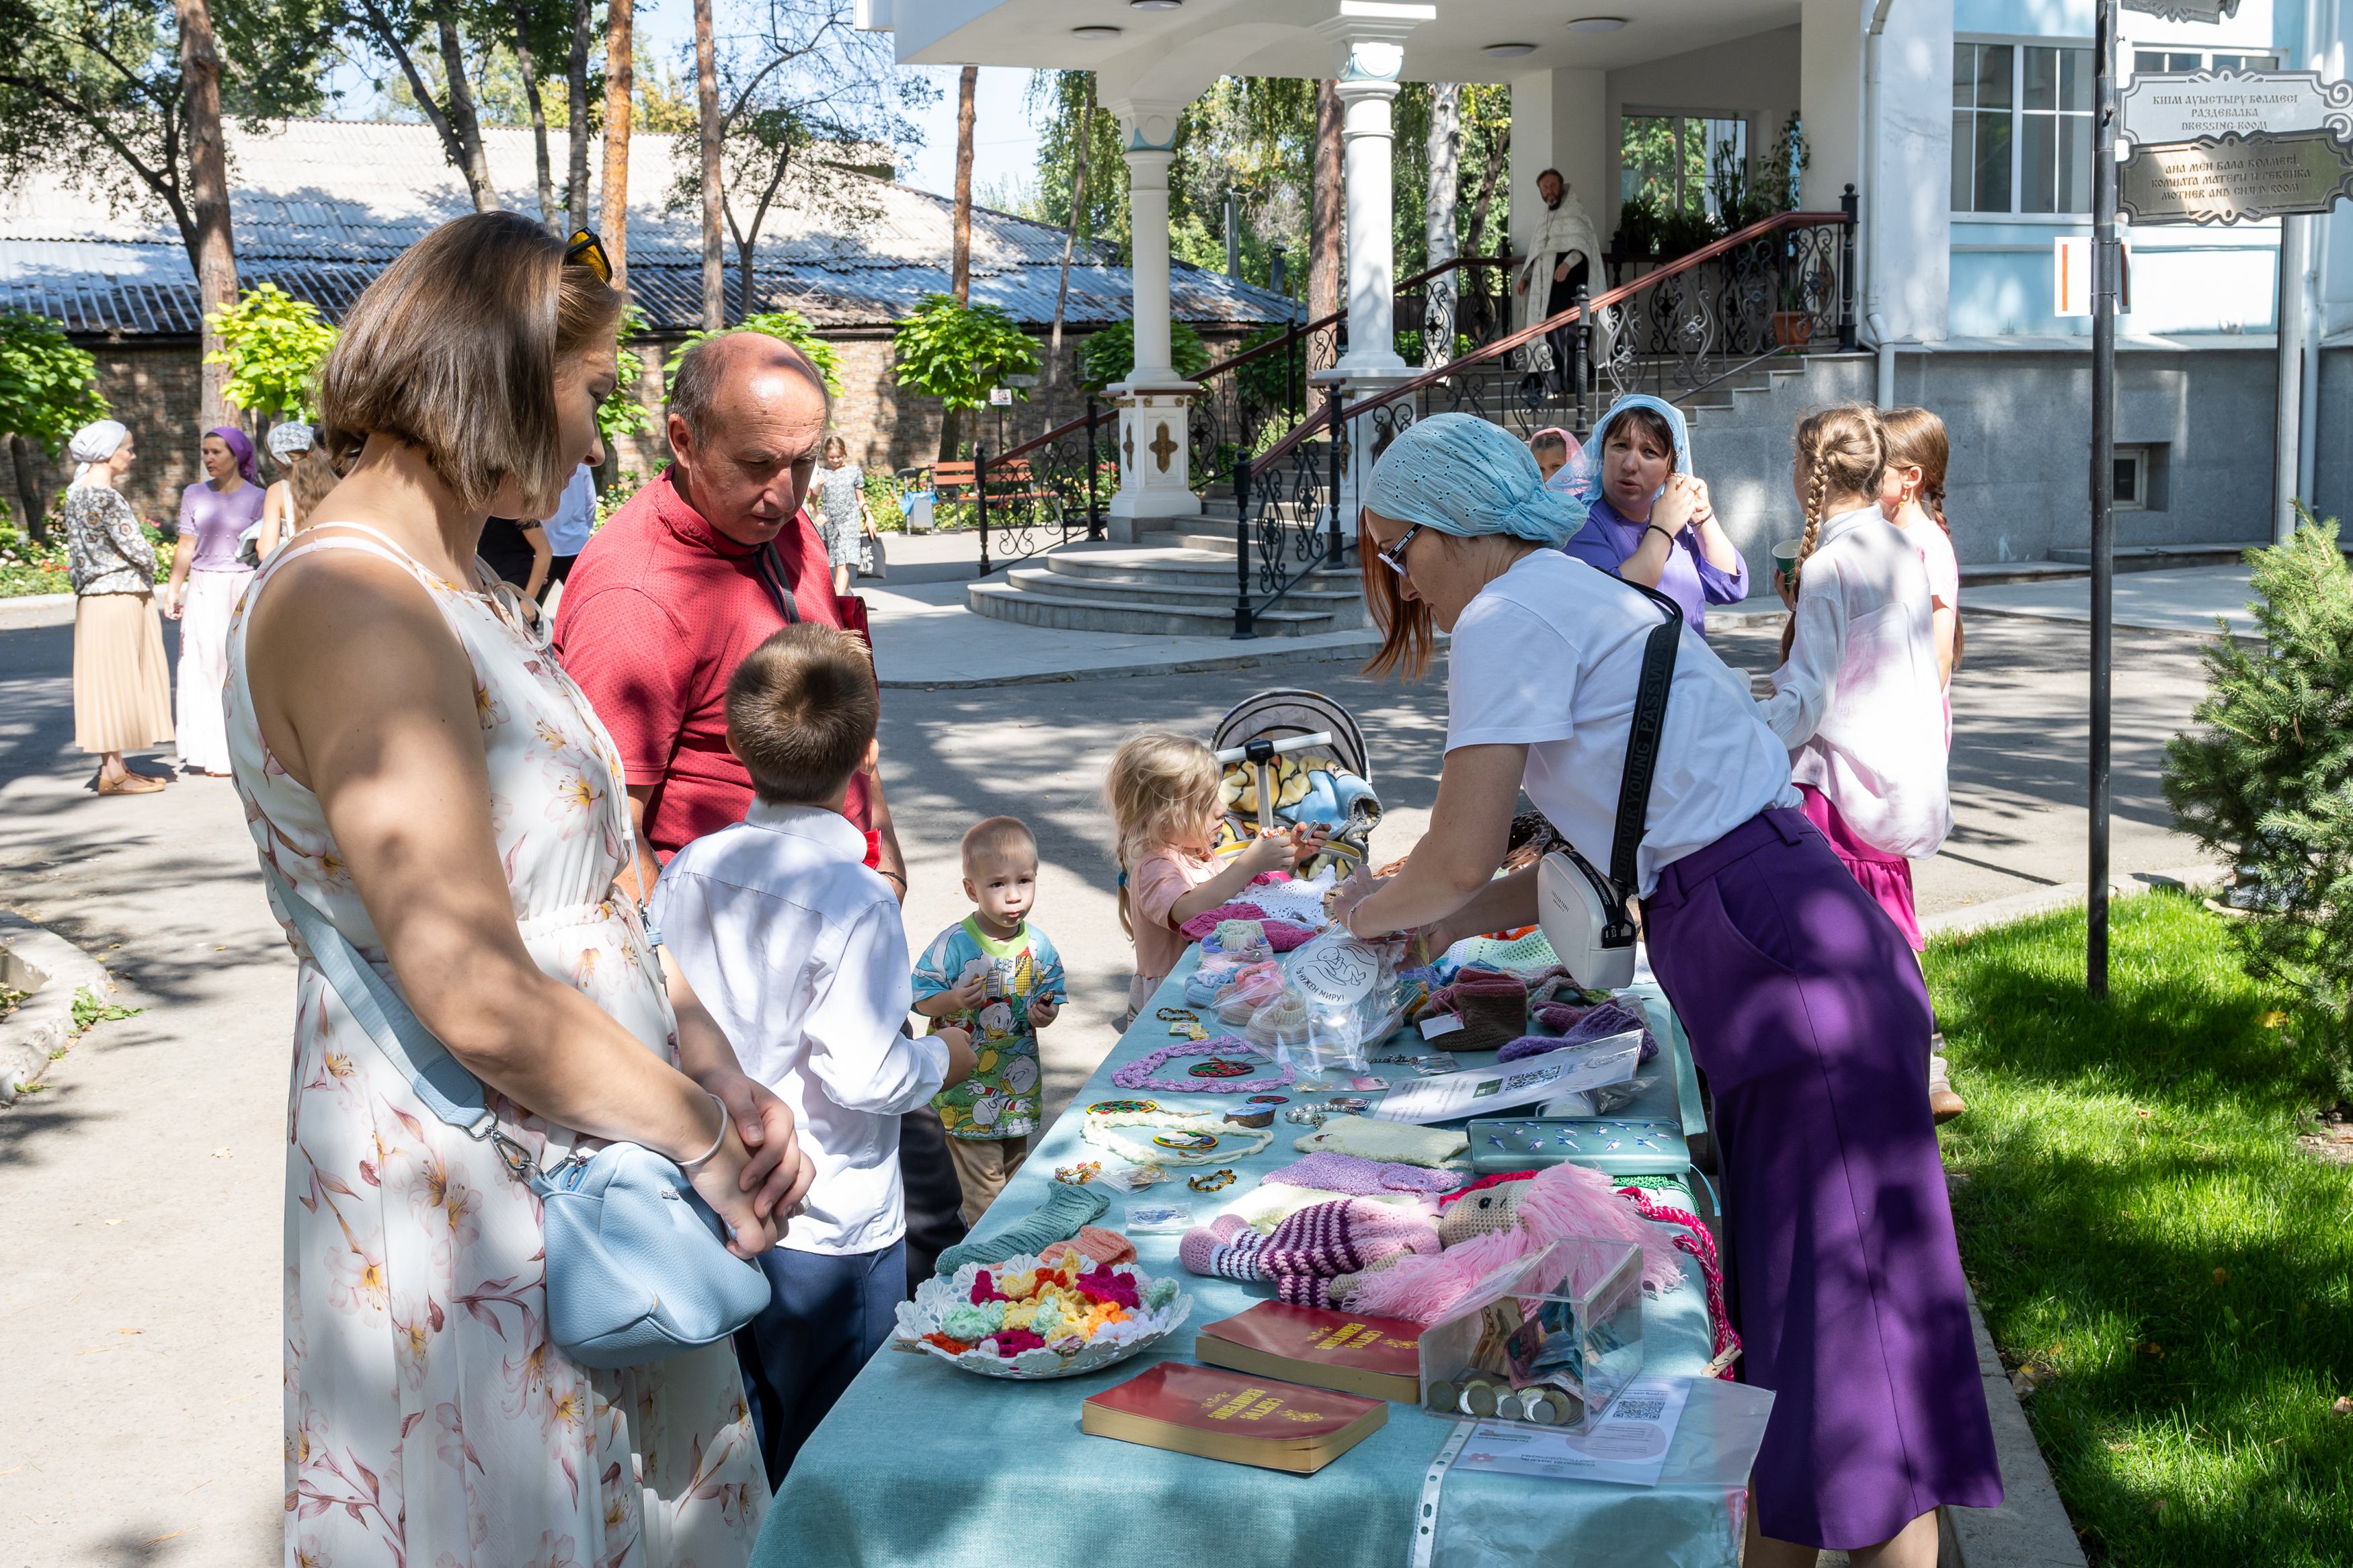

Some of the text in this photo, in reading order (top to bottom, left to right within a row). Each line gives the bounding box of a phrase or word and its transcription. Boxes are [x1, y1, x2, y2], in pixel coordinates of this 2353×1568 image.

[2191, 108, 2259, 118] РАЗДЕВАЛКА
[2181, 121, 2268, 131] DRESSING-ROOM
[2165, 165, 2186, 174] АНА
[2189, 162, 2212, 172] МЕН
[2217, 160, 2244, 171] БАЛА
[2151, 176, 2199, 188] КОМНАТА
[2202, 173, 2247, 185] МАТЕРИ
[2262, 169, 2311, 181] РЕБЕНКА
[2161, 183, 2300, 201] MOTHER AND CHILD ROOM
[1394, 530, 1415, 552] CHRISTIAN DIOR
[1628, 742, 1651, 800] YOUNG
[1589, 872, 1601, 884] YOUNG
[1295, 966, 1345, 1002] ТЫ НУЖЕН МИРУ!
[988, 1098, 999, 1109] 5
